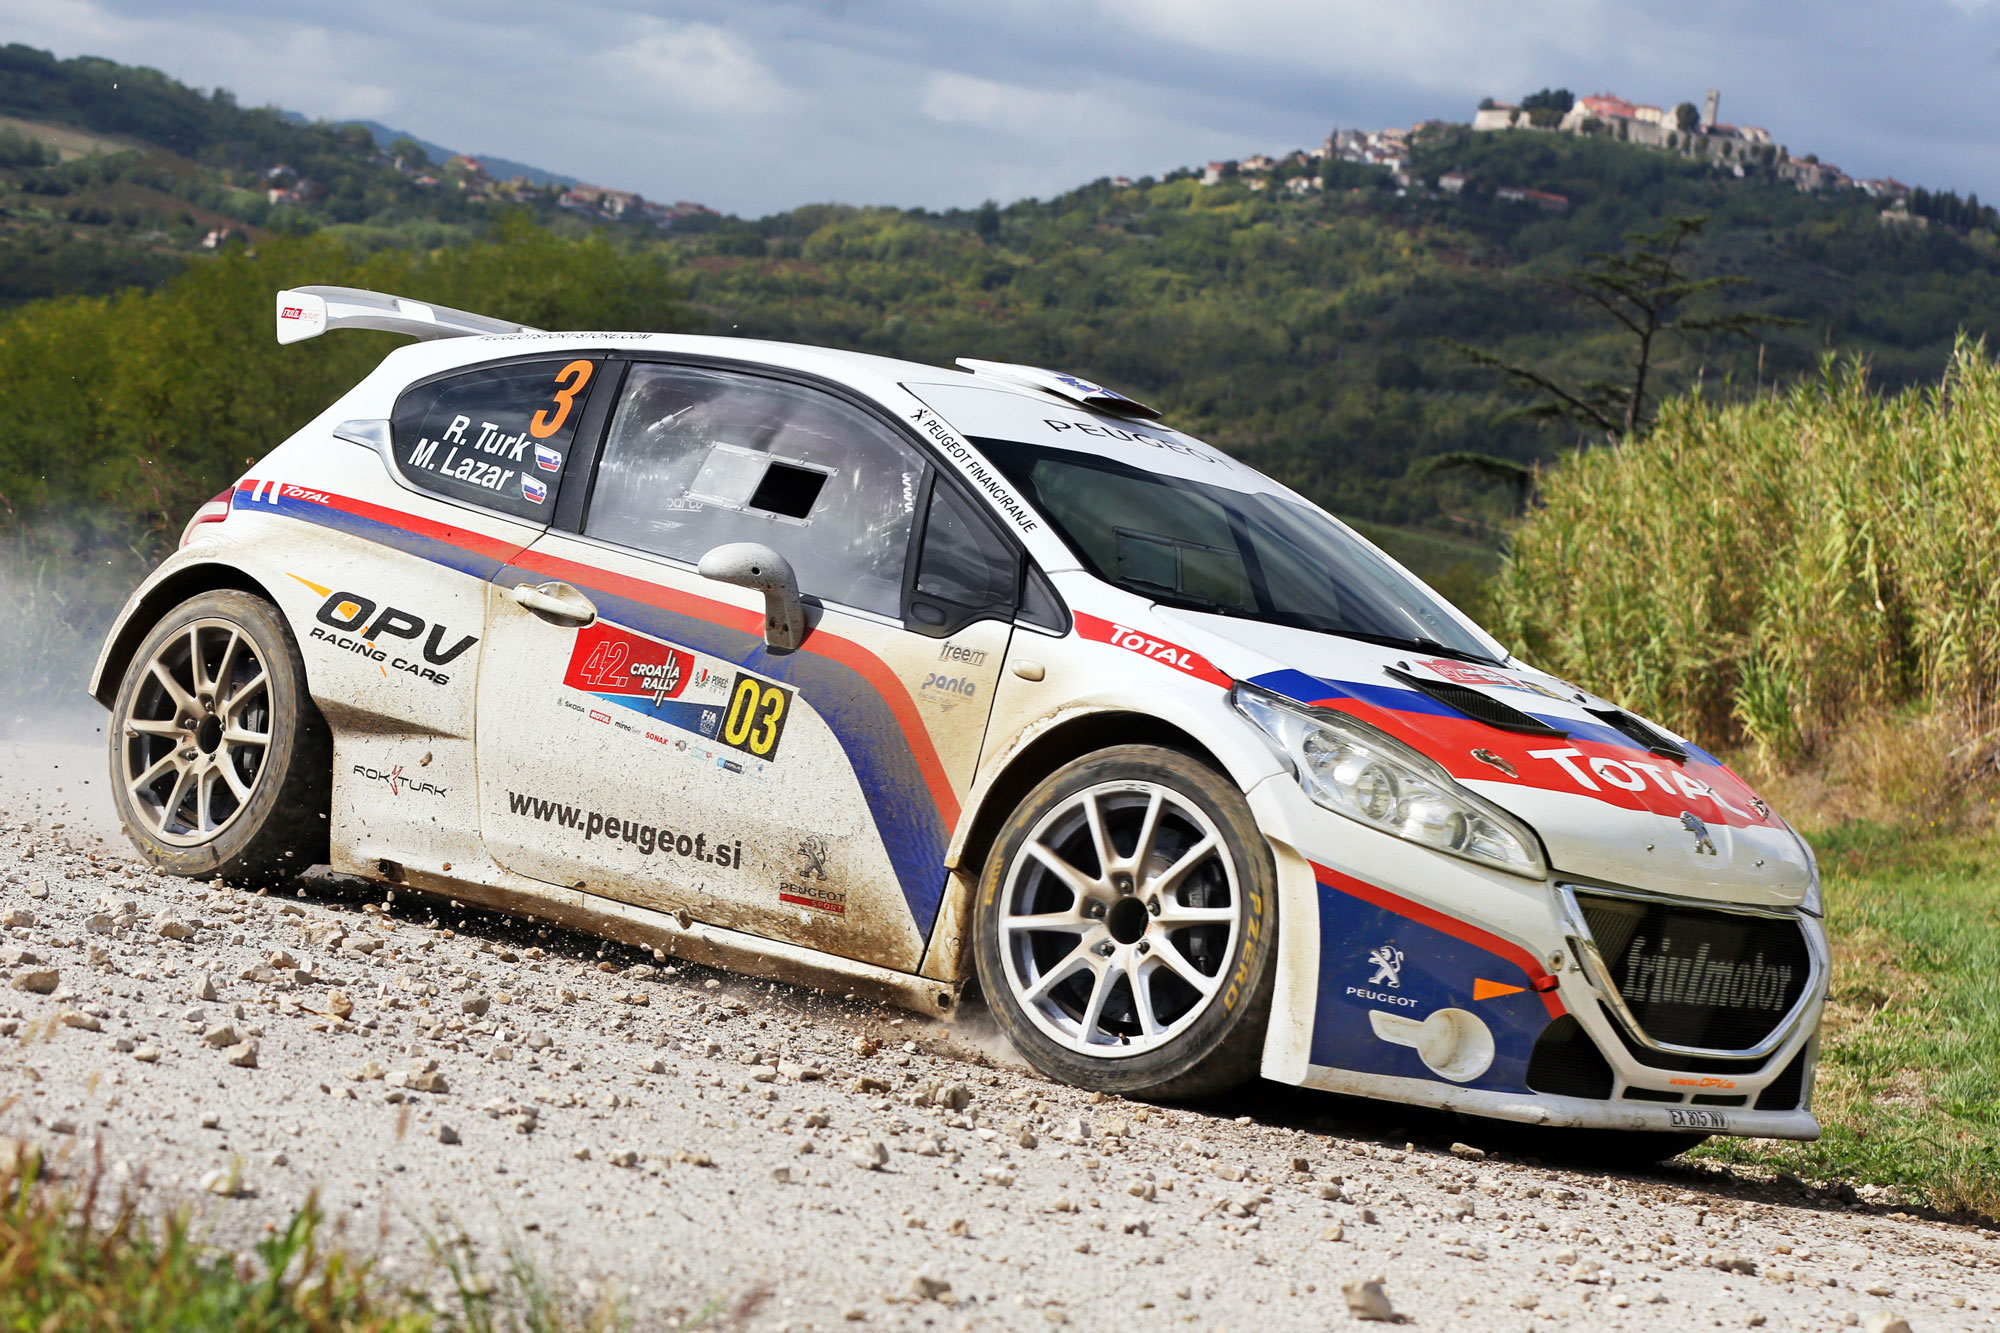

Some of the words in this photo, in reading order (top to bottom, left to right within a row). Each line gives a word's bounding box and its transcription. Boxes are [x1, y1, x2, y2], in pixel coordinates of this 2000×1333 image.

[530, 360, 594, 438] 3
[443, 414, 471, 446] R.
[474, 421, 532, 462] Turk
[1043, 419, 1235, 471] PEUGEOT
[407, 438, 440, 470] M.
[440, 447, 515, 491] Lazar
[923, 419, 973, 463] PEUGEOT
[965, 461, 1038, 533] FINANCIRANJE
[282, 485, 330, 504] TOTAL
[316, 591, 480, 666] OPV
[1109, 623, 1195, 671] TOTAL
[309, 627, 388, 662] RACING
[391, 657, 451, 686] CARS
[580, 641, 630, 687] 42.
[630, 656, 680, 679] CROATIA
[641, 676, 679, 693] RALLY
[645, 731, 669, 745] SONAX
[724, 678, 786, 756] 03
[398, 776, 448, 798] TURK
[1525, 747, 1754, 820] TOTAL
[508, 790, 743, 870] www.peugeot.si
[779, 882, 846, 902] PEUGEOT
[811, 900, 842, 912] SPORT
[1346, 986, 1419, 1008] PEUGEOT
